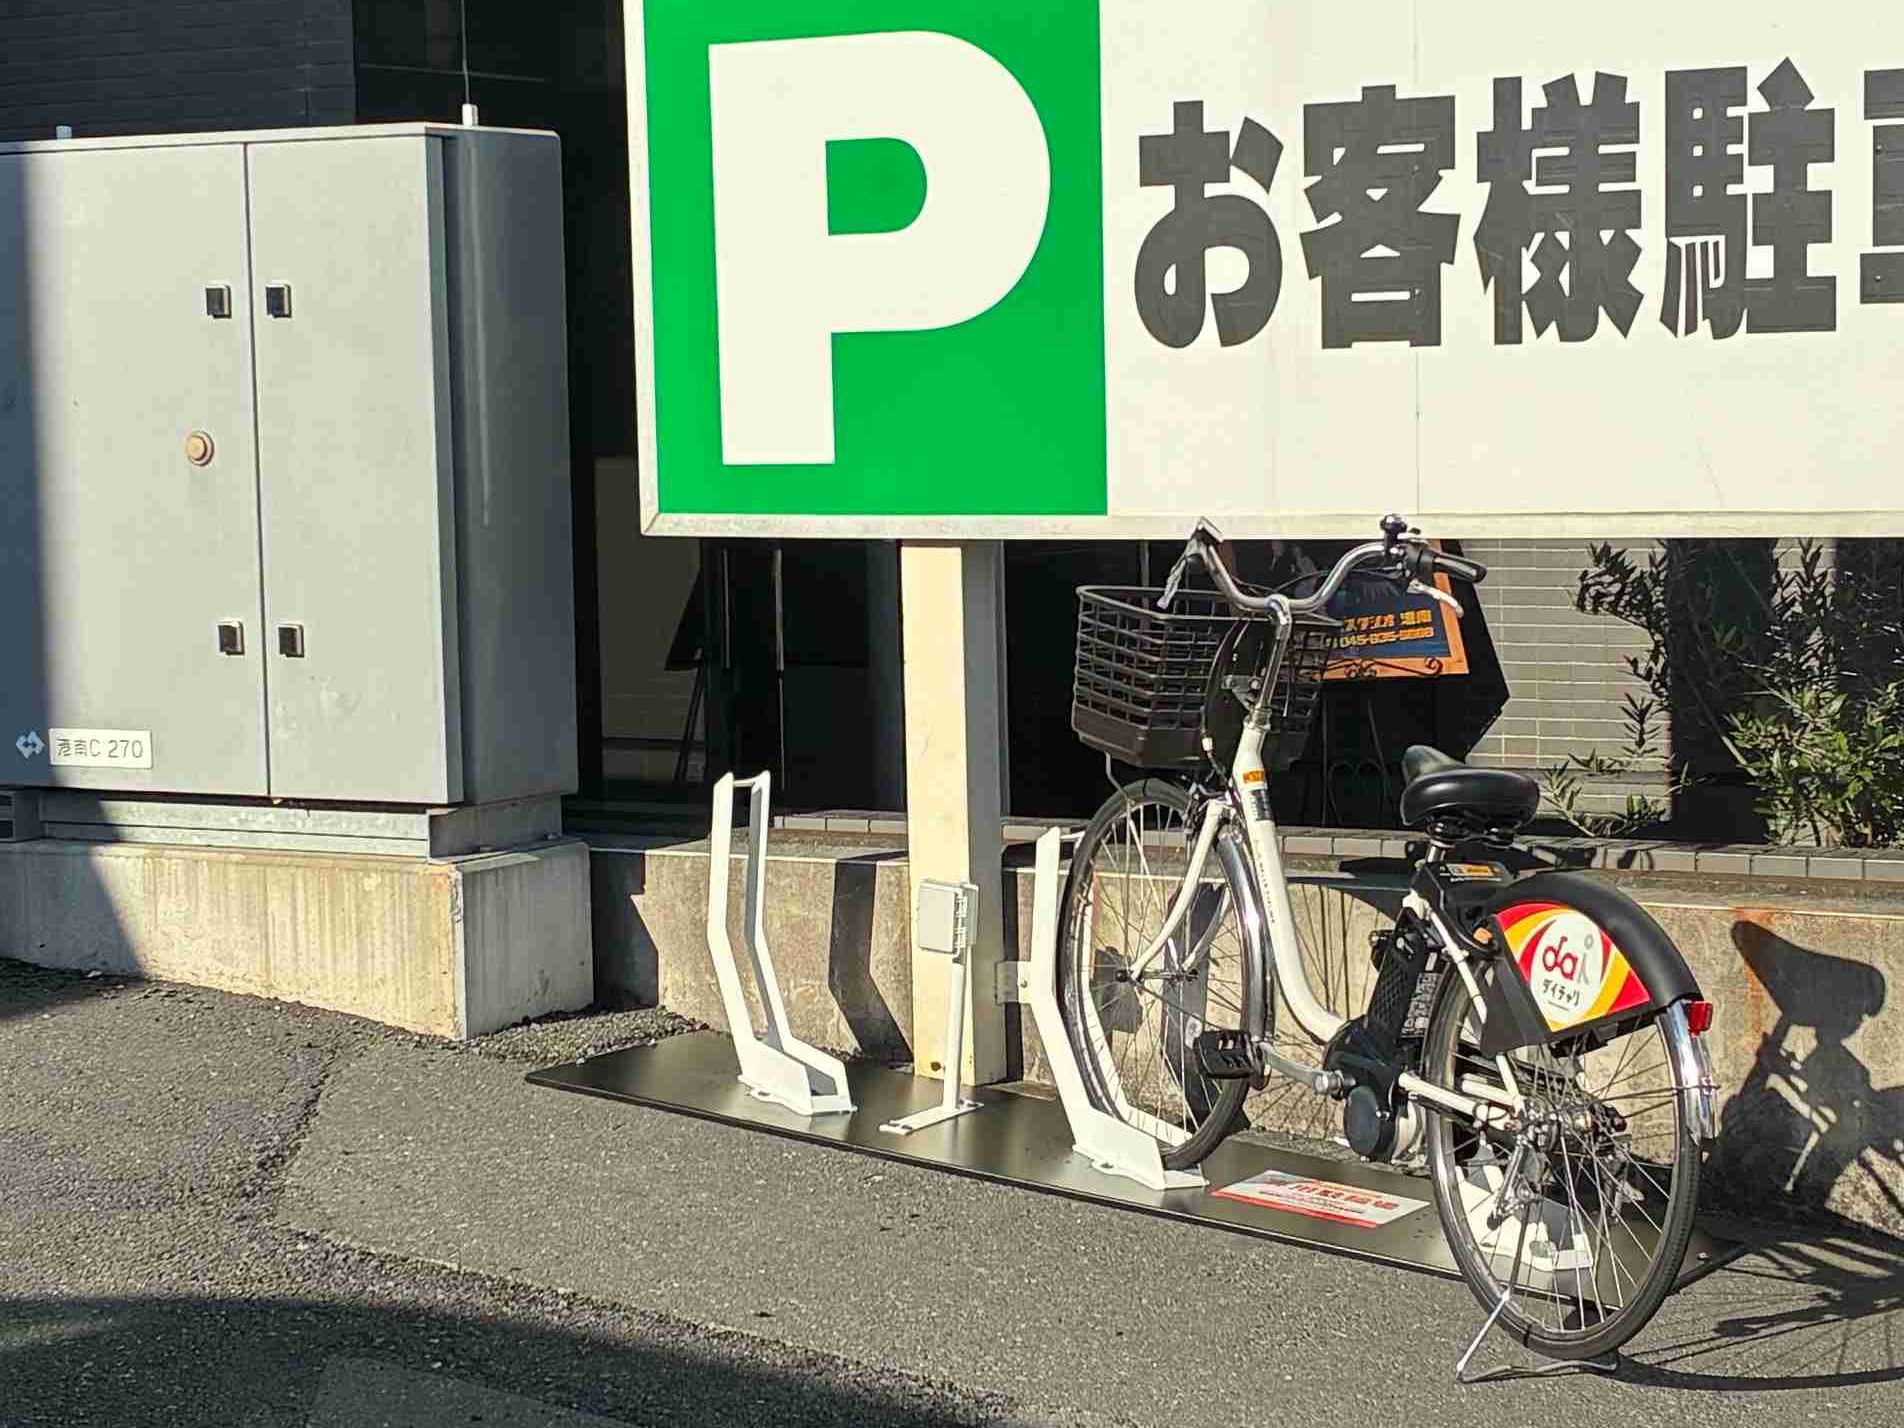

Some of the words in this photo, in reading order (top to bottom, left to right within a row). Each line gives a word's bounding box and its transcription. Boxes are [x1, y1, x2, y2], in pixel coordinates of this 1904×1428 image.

[708, 29, 1051, 466] P
[108, 739, 144, 758] 270
[1542, 933, 1594, 985] dai
[1542, 978, 1581, 1006] ダイチャリ
